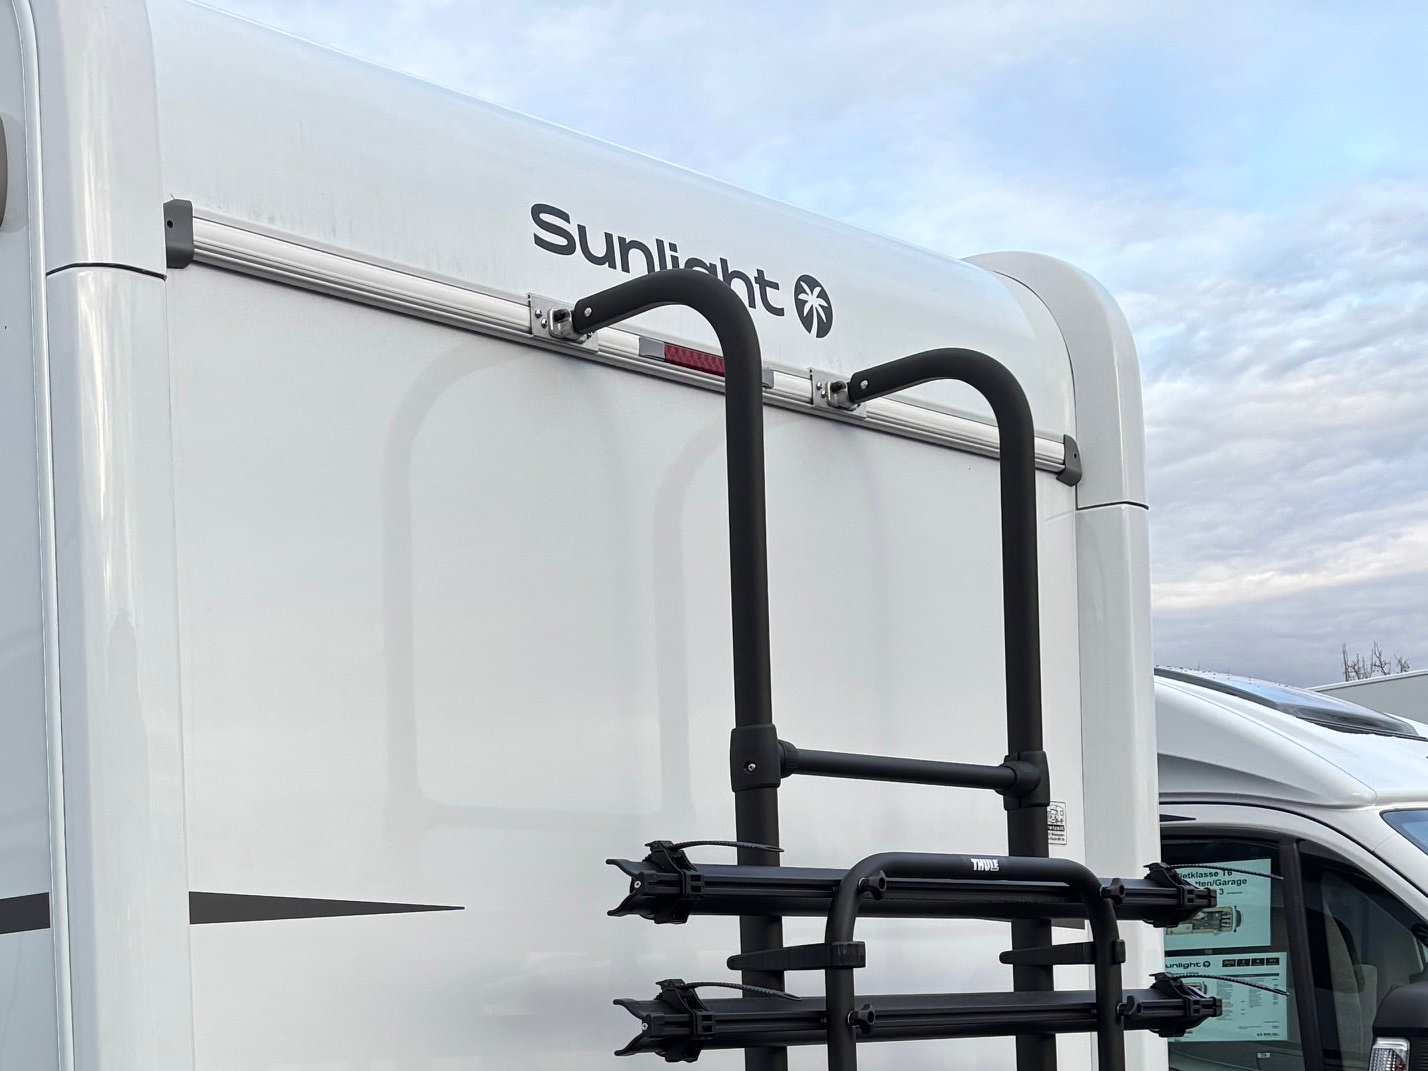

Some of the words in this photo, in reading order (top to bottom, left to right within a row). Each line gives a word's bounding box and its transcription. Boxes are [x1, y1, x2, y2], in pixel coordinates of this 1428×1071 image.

[530, 202, 785, 316] Sunliht
[971, 858, 1000, 872] THULE
[1178, 870, 1219, 880] ietklasse
[1165, 962, 1202, 970] unlight
